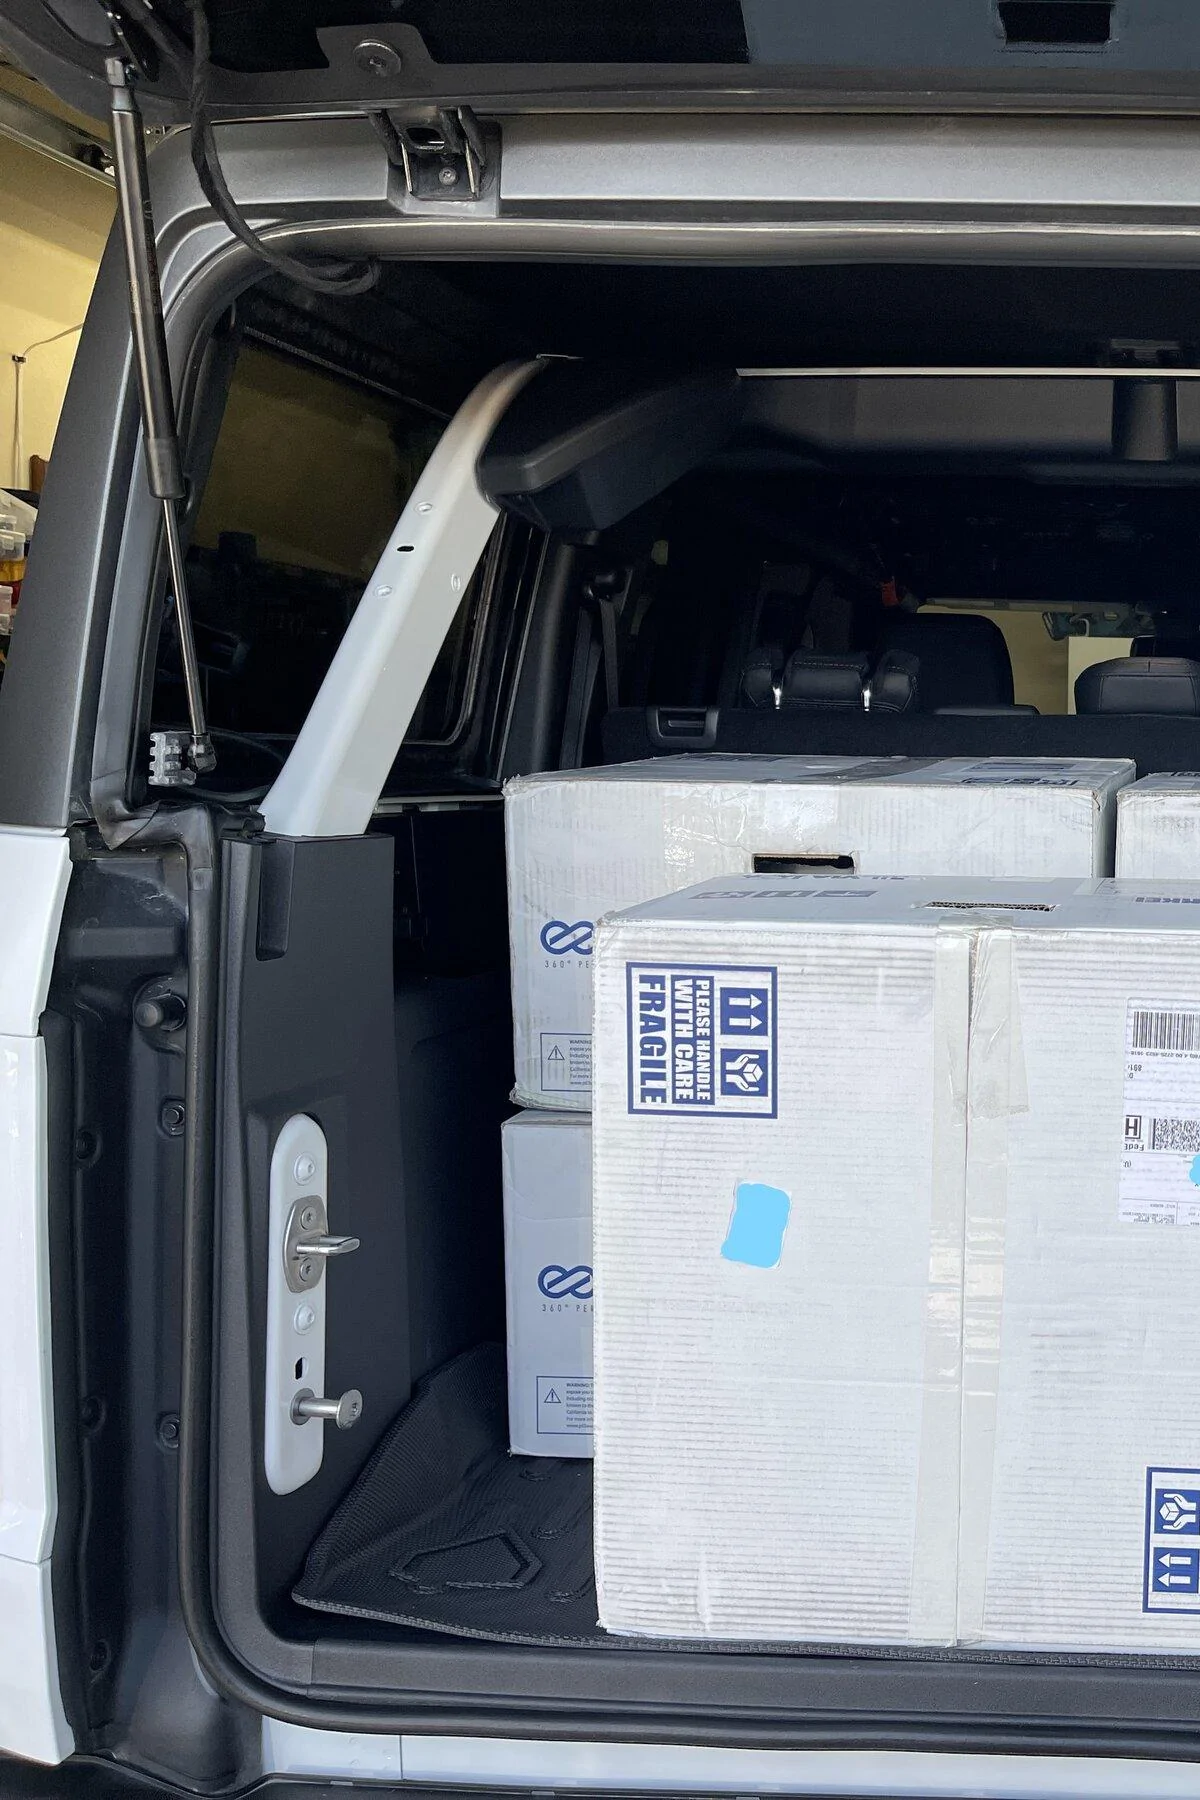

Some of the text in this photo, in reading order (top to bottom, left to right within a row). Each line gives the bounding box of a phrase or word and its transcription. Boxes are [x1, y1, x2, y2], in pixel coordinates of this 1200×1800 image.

[638, 974, 667, 1104] FRAGILE
[674, 978, 694, 1100] WITH CARE
[695, 979, 711, 1101] PLEASE HANDLE
[1125, 1118, 1138, 1137] H
